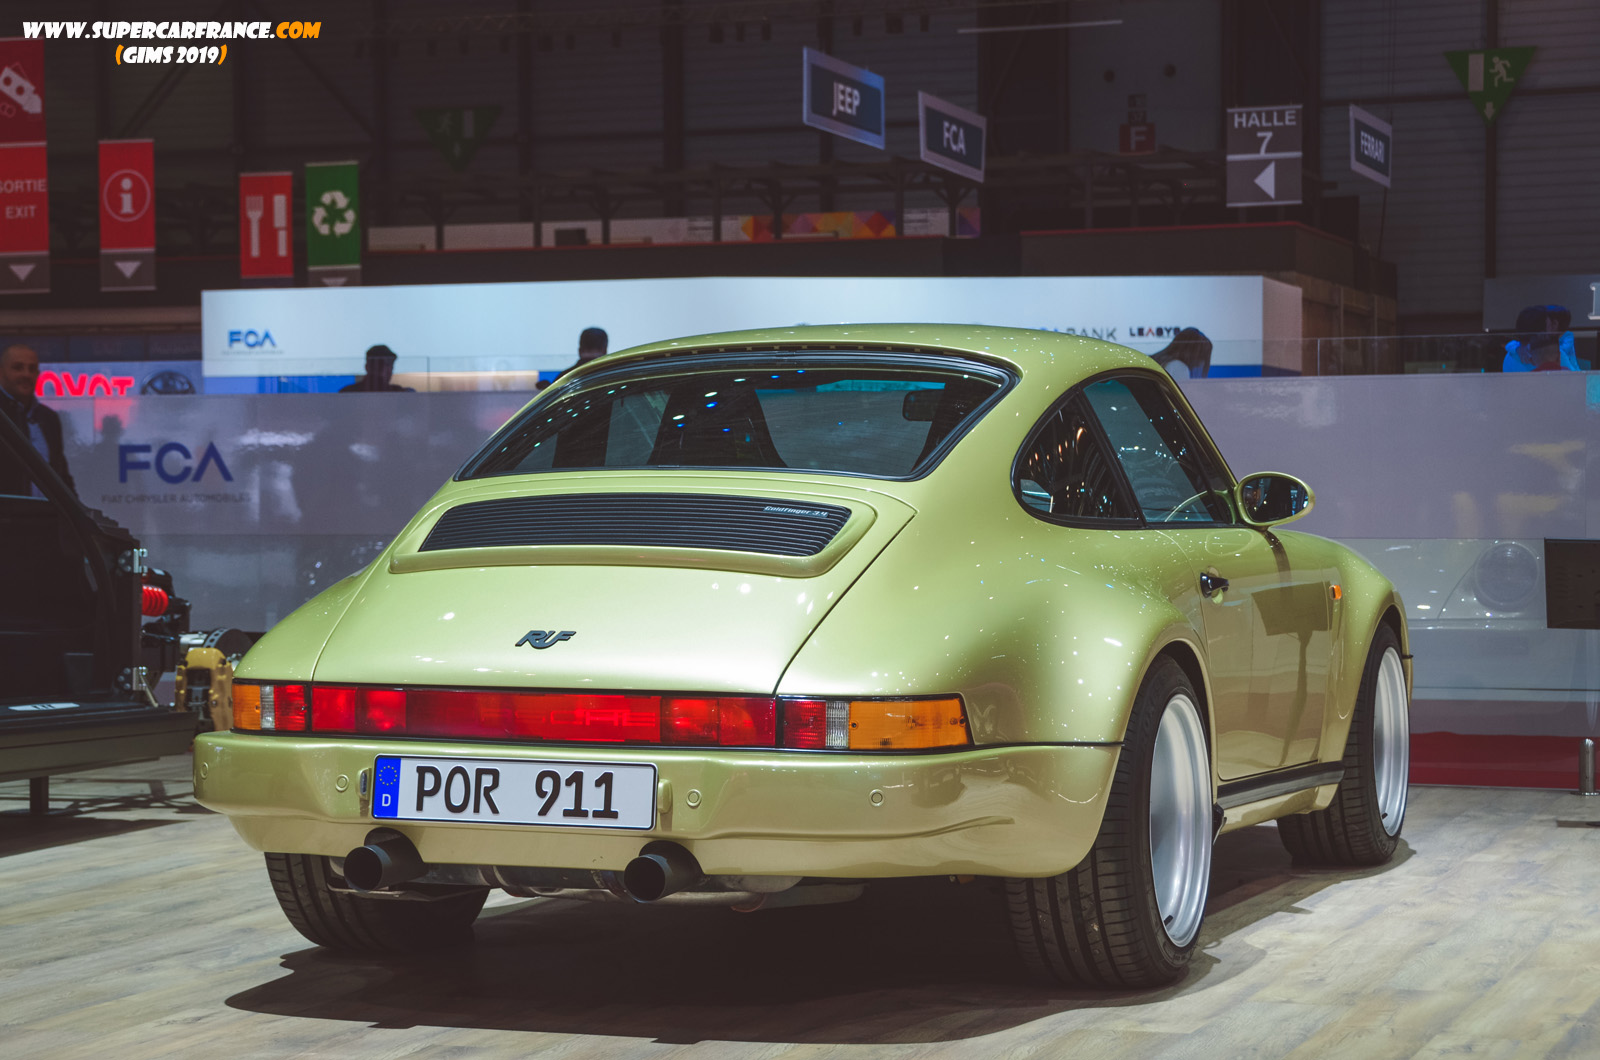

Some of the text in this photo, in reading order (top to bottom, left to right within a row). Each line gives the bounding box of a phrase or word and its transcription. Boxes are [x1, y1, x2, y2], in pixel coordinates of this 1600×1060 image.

[832, 81, 861, 117] JEEP
[1233, 110, 1297, 129] HALLE
[942, 120, 966, 155] FCA
[1130, 126, 1148, 151] F
[1256, 131, 1273, 155] 7
[1360, 130, 1385, 163] FERRARI
[5, 205, 37, 219] EXIT
[228, 329, 277, 348] FCA
[118, 441, 233, 485] FCA
[515, 630, 577, 649] RUF
[381, 793, 391, 807] D
[416, 765, 619, 819] POR 911
